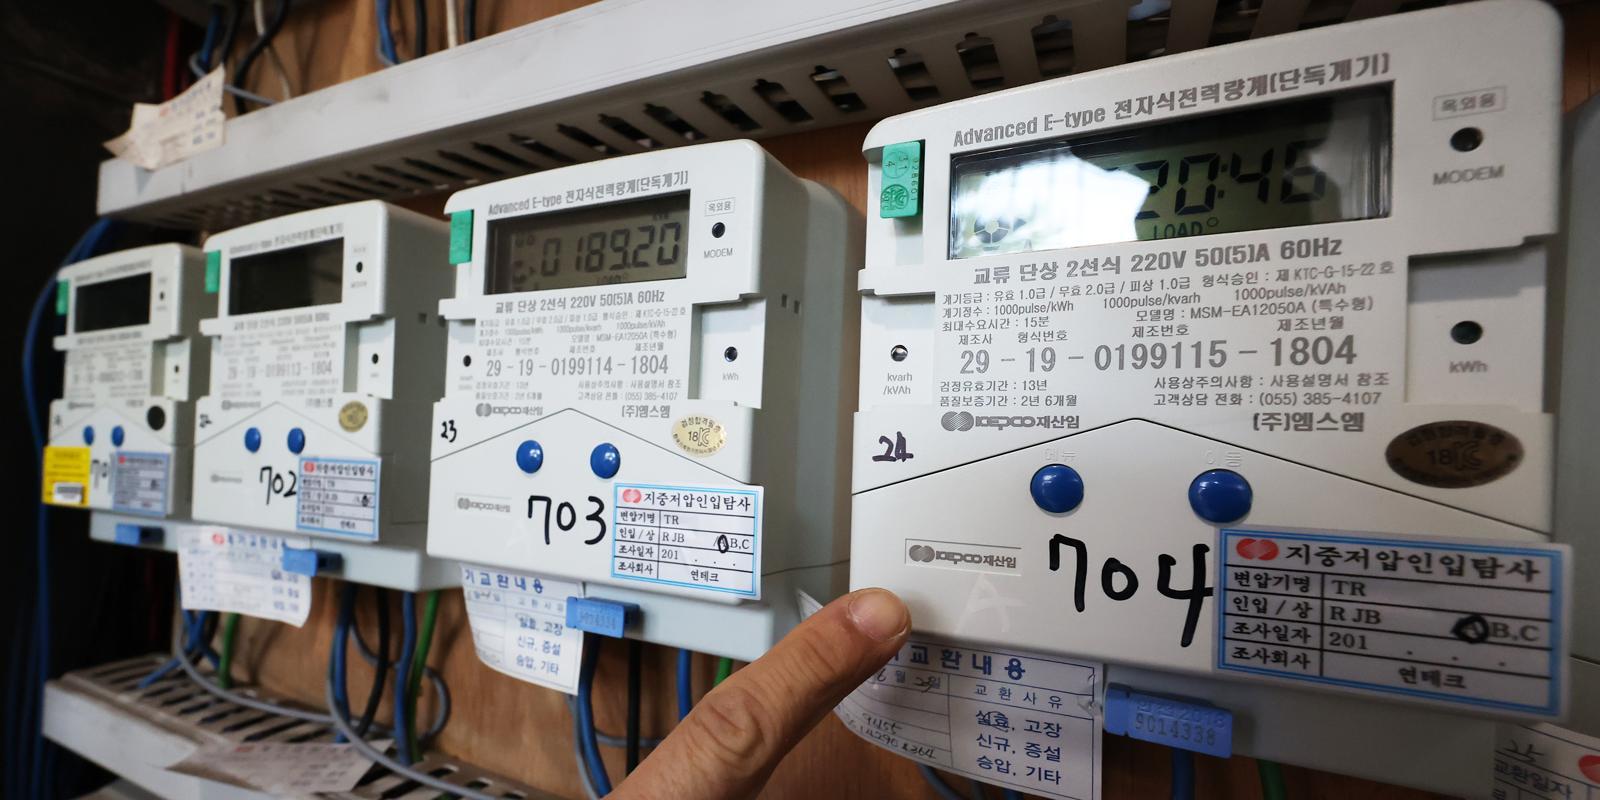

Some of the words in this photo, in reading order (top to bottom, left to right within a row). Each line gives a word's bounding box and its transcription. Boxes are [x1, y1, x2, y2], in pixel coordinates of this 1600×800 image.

[954, 116, 1037, 147] Advanced
[1044, 105, 1105, 131] E-type
[1433, 165, 1505, 186] MODEM
[488, 199, 530, 217] Advanced
[532, 193, 562, 210] E-type
[703, 247, 734, 259] MODEM
[973, 266, 1011, 285] 교류
[1020, 261, 1059, 282] 단상
[1066, 255, 1121, 278] 2선식
[1131, 249, 1187, 273] 220V
[1280, 237, 1343, 260] 60Hz
[942, 290, 983, 306] 계기등급
[994, 290, 1015, 303] 유효
[1019, 287, 1046, 301] 1.0급
[1059, 286, 1082, 298] 무효
[1086, 282, 1115, 297] 2.0급
[1131, 280, 1154, 293] 피상
[1160, 276, 1191, 291] 1.0급
[1202, 271, 1259, 287] 형식승인
[1294, 263, 1376, 281] KTC-G-15-22
[518, 300, 537, 313] 단상
[540, 297, 567, 311] 2선식
[570, 295, 597, 309] 220V
[638, 289, 665, 304] 60Hz
[942, 305, 983, 319] 계기정수
[994, 300, 1075, 317] 1000pulse/kWh
[1104, 293, 1201, 309] 1000pulse/kvarh
[1235, 282, 1347, 301] 1000pulse/kVAh
[942, 318, 1010, 332] 최대수요시간
[1024, 315, 1050, 329] 15분
[1136, 308, 1176, 322] 모델명
[1190, 302, 1306, 319] MSM-EA12050A
[1311, 296, 1374, 314] (특수형)
[959, 334, 993, 345] 제조사
[1017, 330, 1069, 343] 형식번호
[1131, 324, 1190, 340] 제조번호
[1276, 316, 1344, 332] 제조년월
[486, 360, 502, 377] 29
[520, 358, 534, 376] 19
[551, 355, 612, 376] 0199114
[632, 354, 669, 375] 1804
[960, 349, 990, 374] 29
[1026, 346, 1057, 373] 19
[1094, 340, 1228, 371] 0199115
[1270, 334, 1357, 367] 1804
[722, 373, 739, 381] kWh
[887, 371, 913, 383] kvarh
[1449, 360, 1488, 373] kWh
[883, 384, 911, 396] /kVAh
[940, 379, 1009, 393] 검정유효기간
[1022, 379, 1048, 392] 13년
[1154, 375, 1253, 390] 사용상주의사항
[1270, 373, 1349, 388] 사용설명서
[940, 394, 1009, 407] 품질보증기간
[1021, 394, 1040, 407] 2년
[1045, 394, 1077, 407] 6개월
[1153, 392, 1208, 407] 고객상담
[1215, 392, 1243, 406] 전화
[1259, 392, 1297, 407] (055)
[1303, 390, 1382, 406] 385-4107
[441, 419, 457, 443] 23
[872, 431, 914, 462] 24
[260, 466, 297, 505] 702
[643, 491, 751, 512] 지중저압인입탐사
[528, 495, 607, 545] 703
[664, 515, 679, 525] TR
[619, 527, 636, 540] 인입
[646, 530, 655, 542] 상
[662, 532, 670, 542] R
[672, 533, 685, 543] JB
[618, 544, 654, 558] 조사일자
[661, 549, 679, 560] 201
[1286, 544, 1539, 583] 지중저압인입탐사
[618, 561, 653, 575] 조사회사
[690, 569, 720, 582] 연테크
[1233, 570, 1311, 593] 변압기명
[1331, 579, 1366, 597] TR
[1049, 533, 1214, 648] 704
[1232, 595, 1268, 615] 인입
[1296, 602, 1313, 620] 상
[1330, 607, 1345, 622] R
[1351, 607, 1381, 625] JB
[1232, 621, 1311, 645] 조사일자
[1329, 631, 1369, 651] 201
[894, 644, 1026, 681] 교환내용
[1231, 646, 1311, 668] 조사회사
[1398, 666, 1468, 690] 연테크
[1024, 718, 1062, 739] 고장
[1024, 742, 1062, 762] 증설
[1026, 765, 1062, 785] 기타
